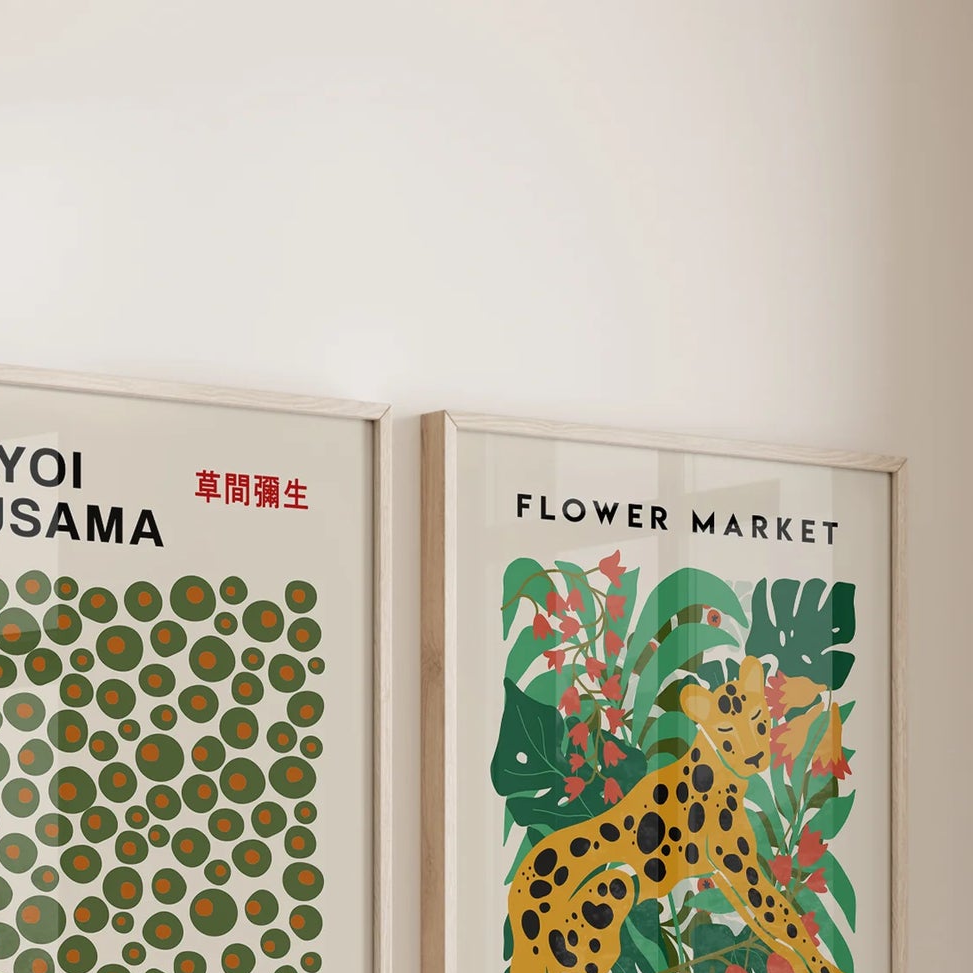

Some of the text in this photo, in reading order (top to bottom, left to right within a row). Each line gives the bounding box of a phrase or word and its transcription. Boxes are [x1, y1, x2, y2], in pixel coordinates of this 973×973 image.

[195, 470, 308, 509] 草間彌生
[517, 494, 839, 544] FLOWER MARKET
